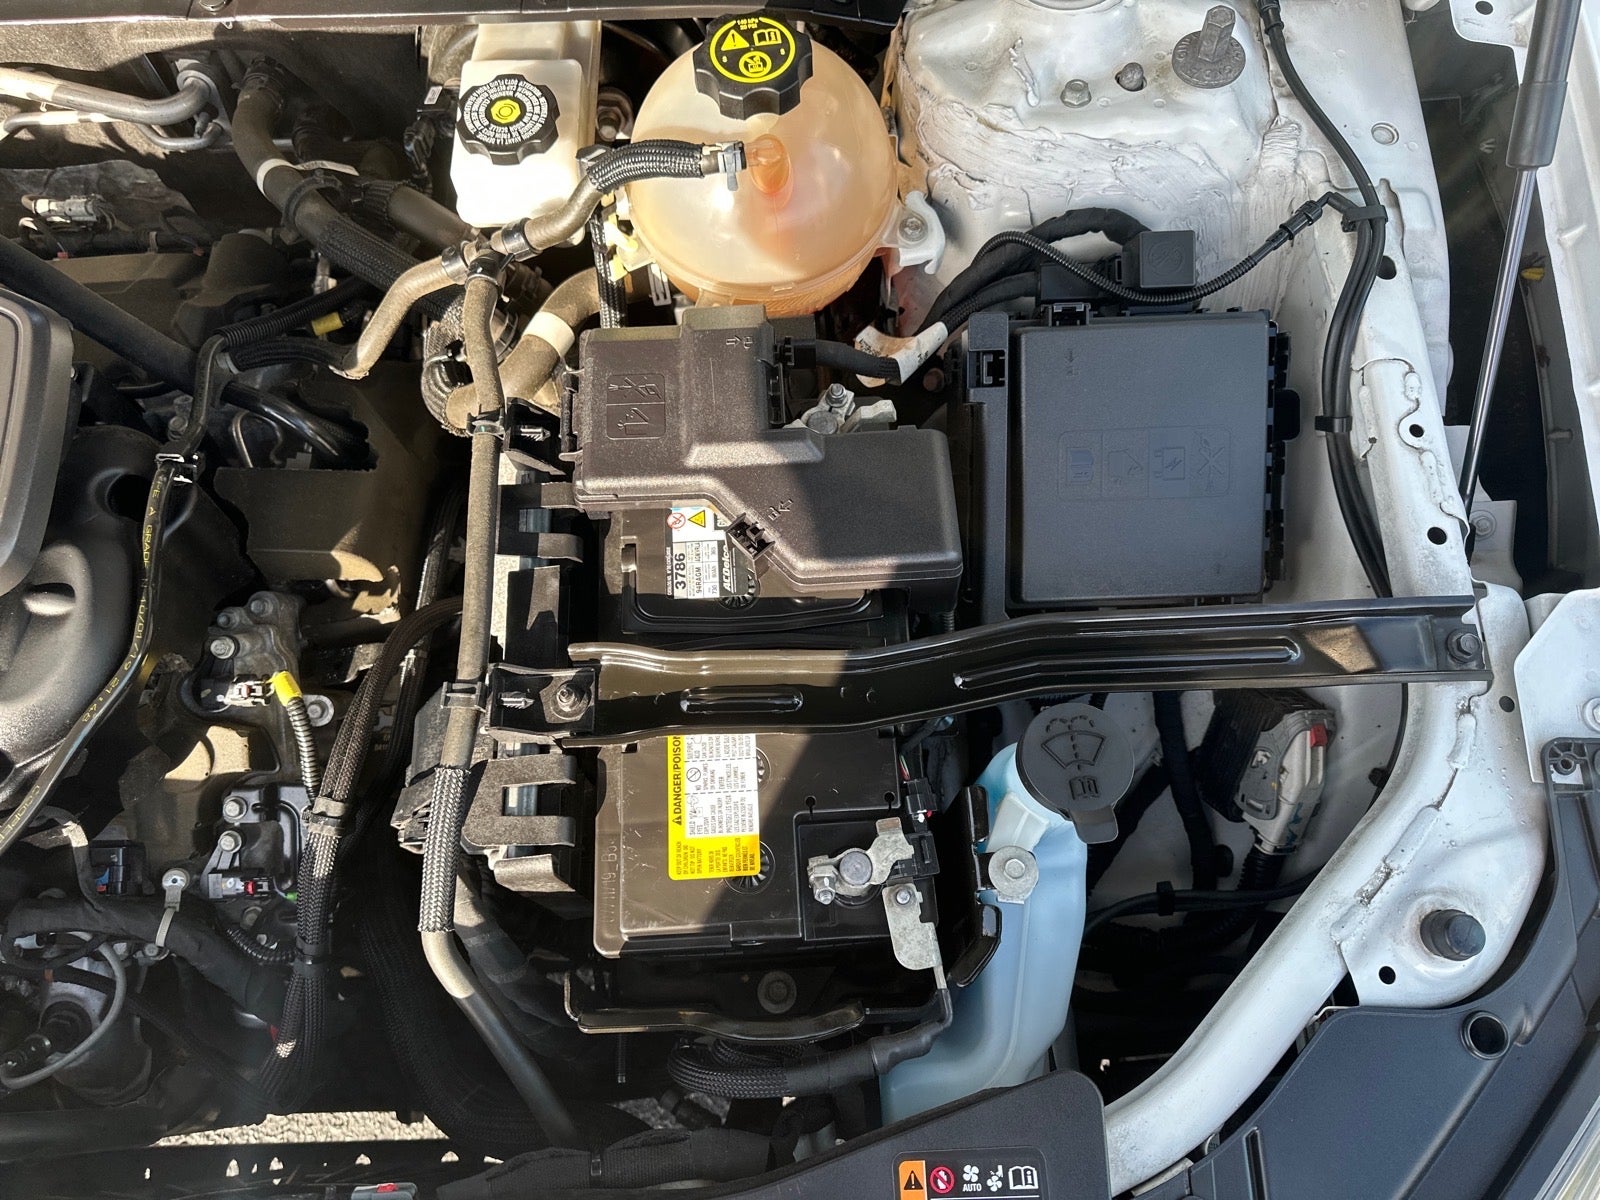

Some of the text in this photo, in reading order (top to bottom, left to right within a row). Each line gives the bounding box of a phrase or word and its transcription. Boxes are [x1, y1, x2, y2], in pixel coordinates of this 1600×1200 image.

[674, 553, 686, 590] 3786
[722, 545, 731, 591] ACDelco
[962, 1183, 982, 1192] AUTO
